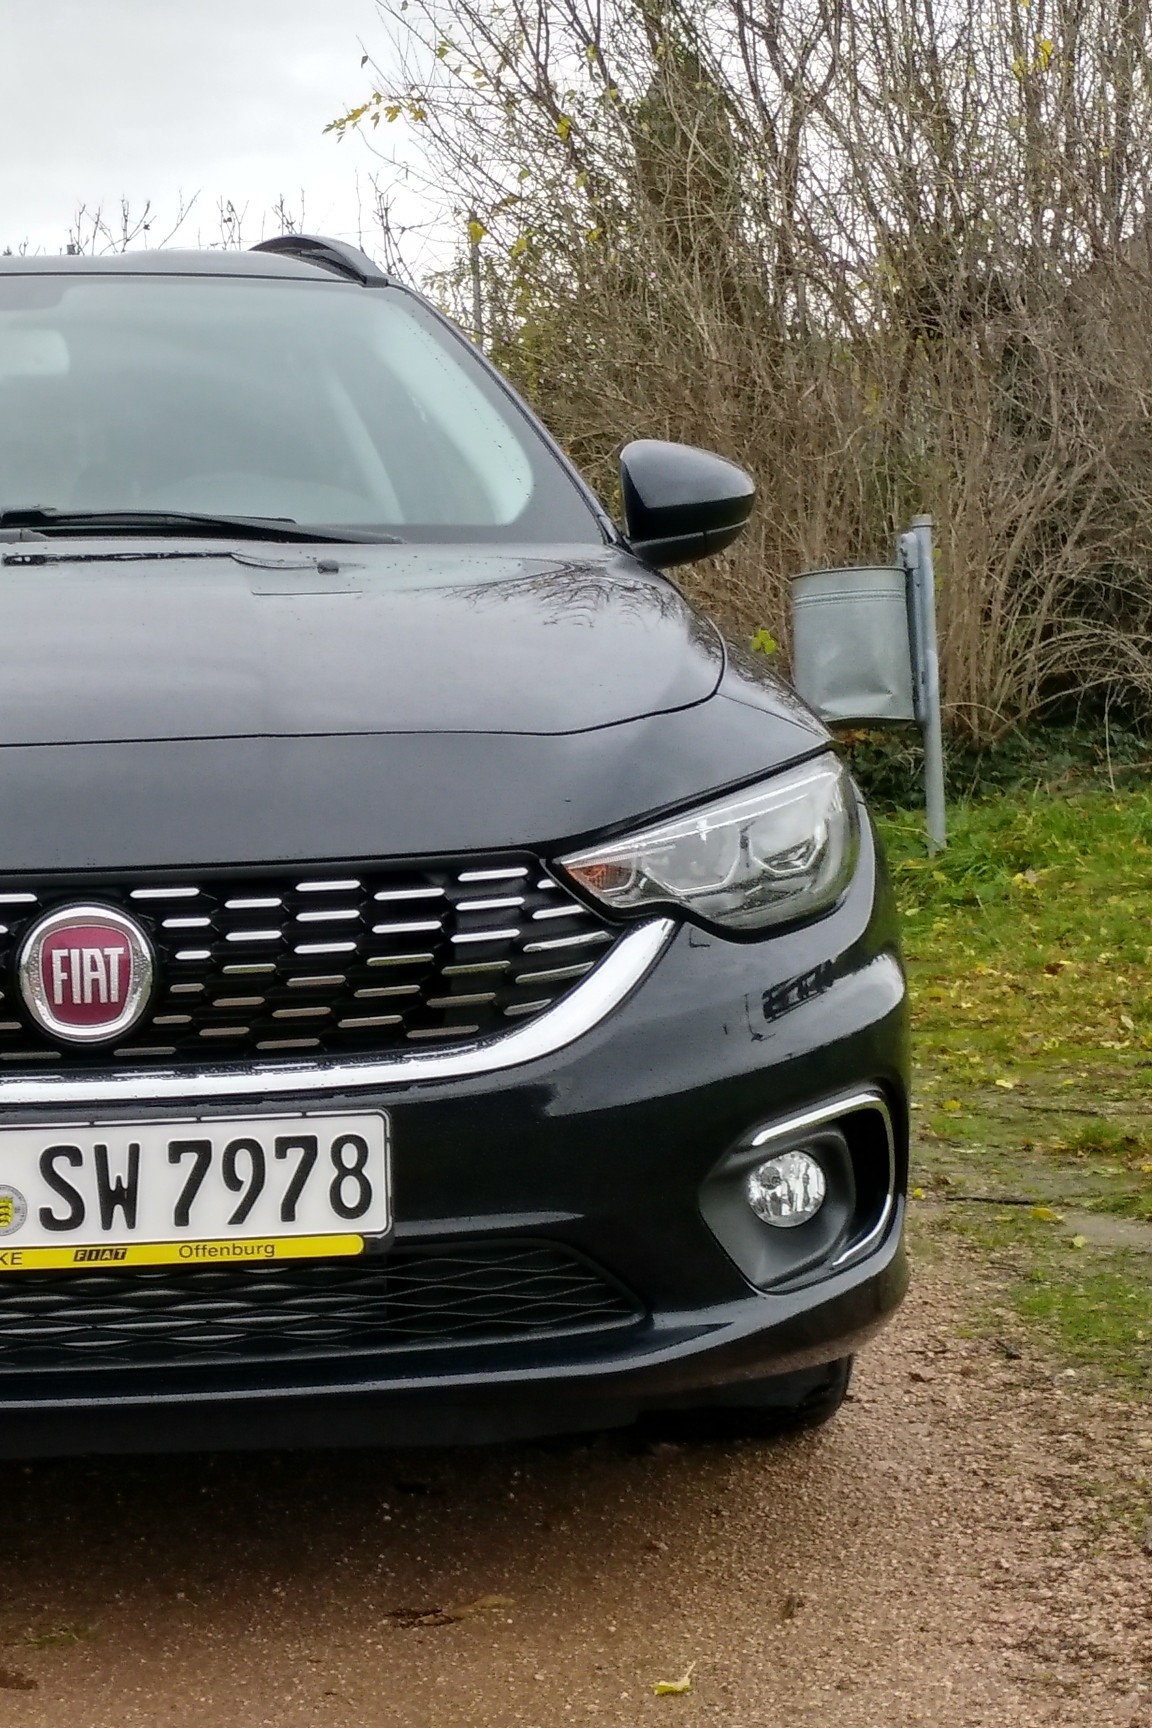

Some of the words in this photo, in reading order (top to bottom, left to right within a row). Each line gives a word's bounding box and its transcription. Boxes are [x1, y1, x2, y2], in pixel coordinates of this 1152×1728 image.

[51, 947, 124, 1005] FIAT
[38, 1142, 141, 1232] SW
[167, 1133, 371, 1227] 7978
[72, 1247, 128, 1263] FIAT
[177, 1241, 277, 1260] Offenburg
